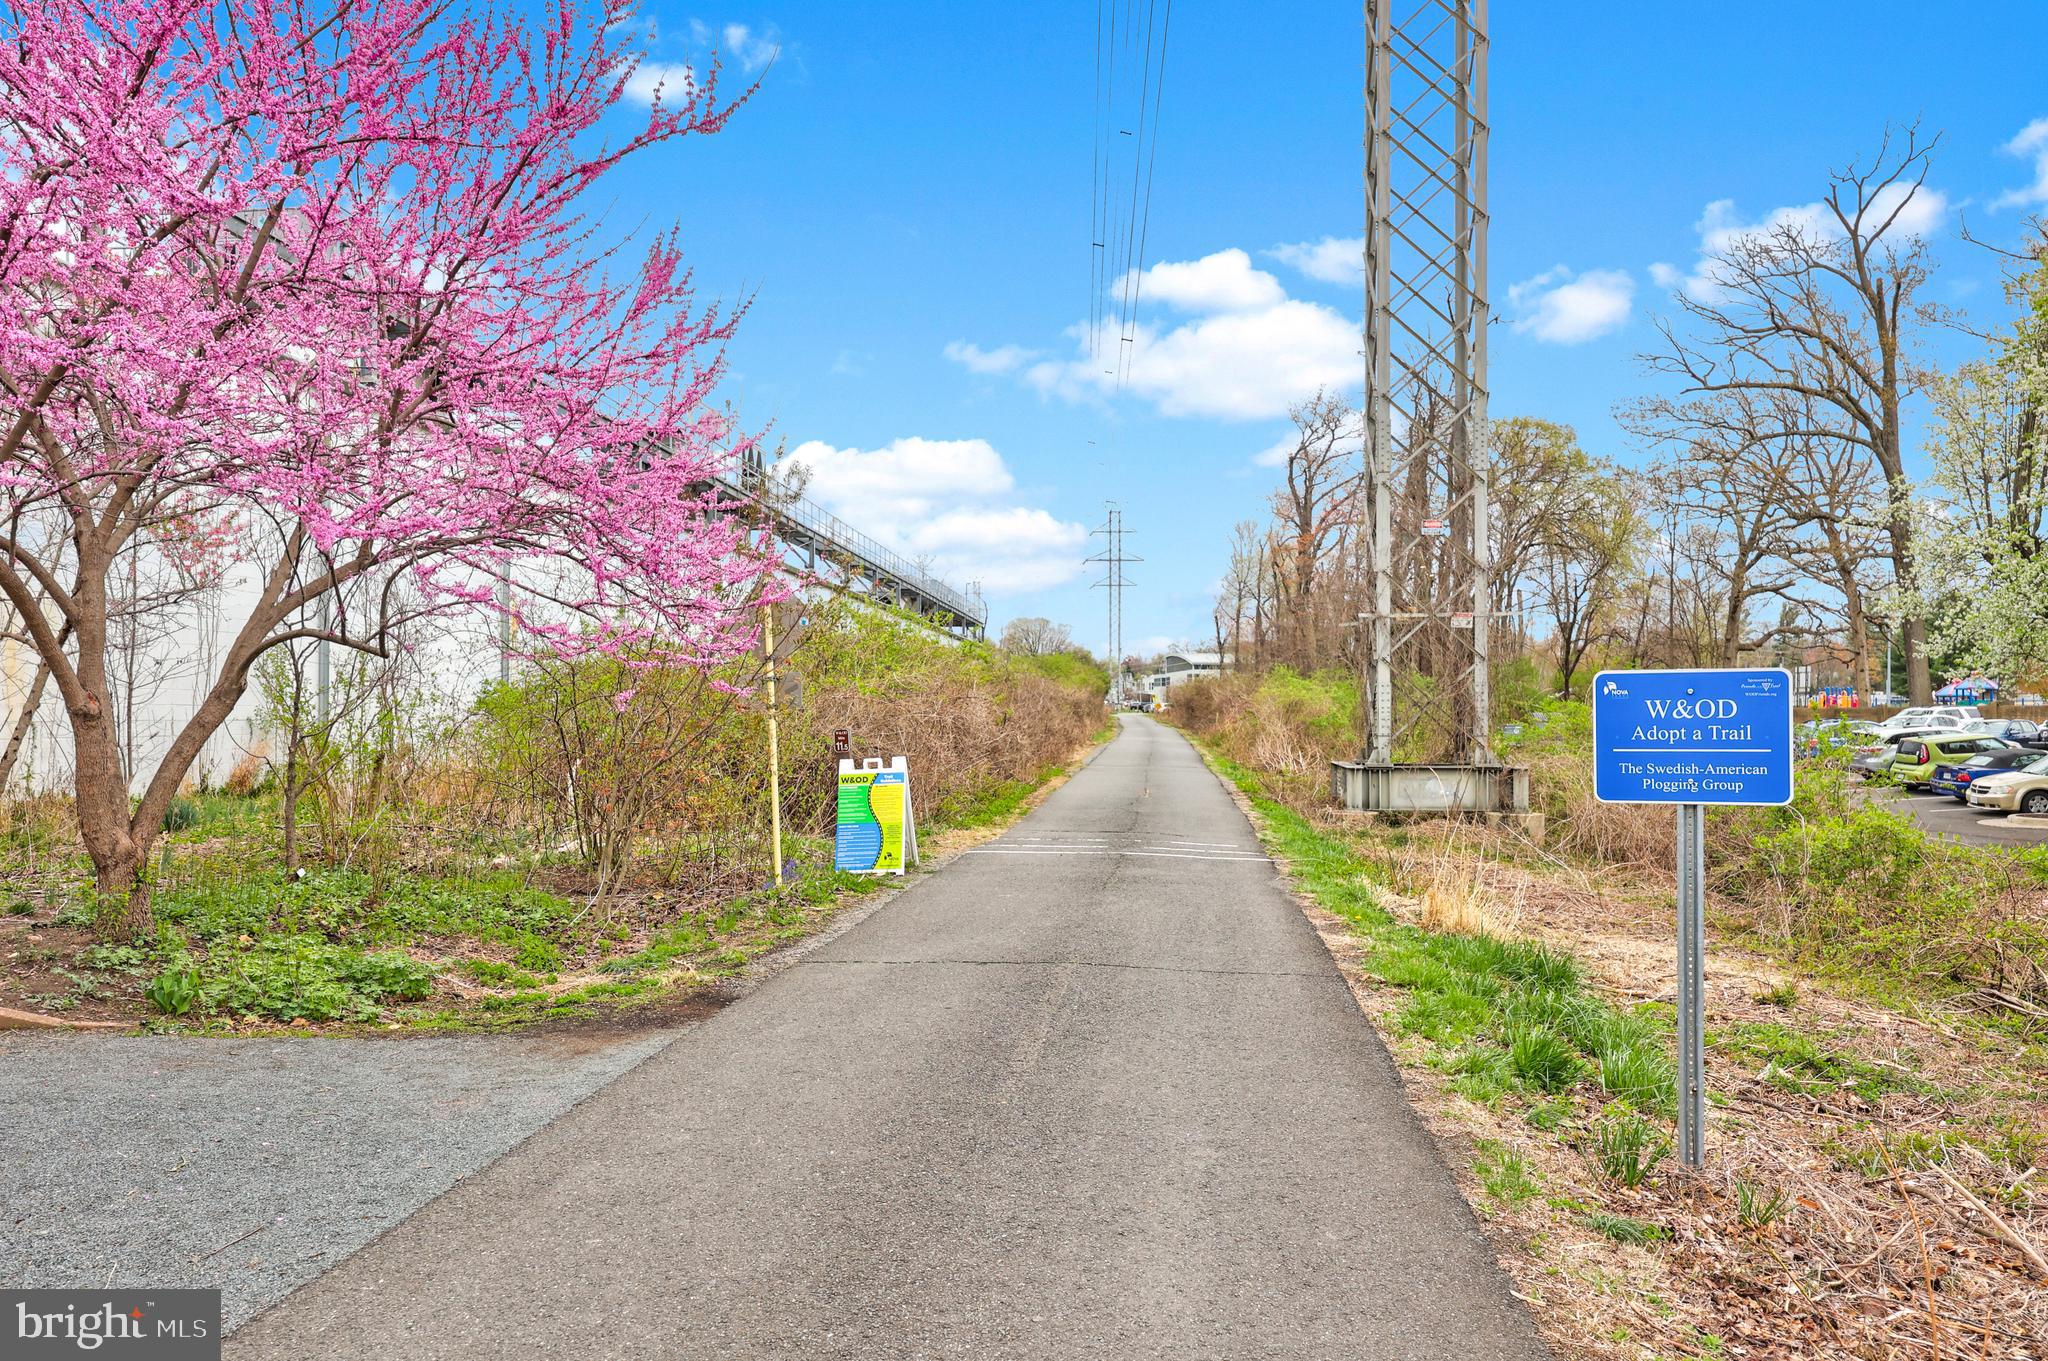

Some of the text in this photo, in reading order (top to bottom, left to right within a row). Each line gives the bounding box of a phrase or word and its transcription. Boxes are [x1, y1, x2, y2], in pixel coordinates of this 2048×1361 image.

[1644, 698, 1738, 719] W&OD
[1631, 724, 1752, 745] Adopt a Trail
[835, 741, 849, 751] 11.5
[1619, 762, 1768, 775] The Swedish-American
[841, 776, 869, 784] W&OD
[1643, 778, 1744, 793] Plogging Group
